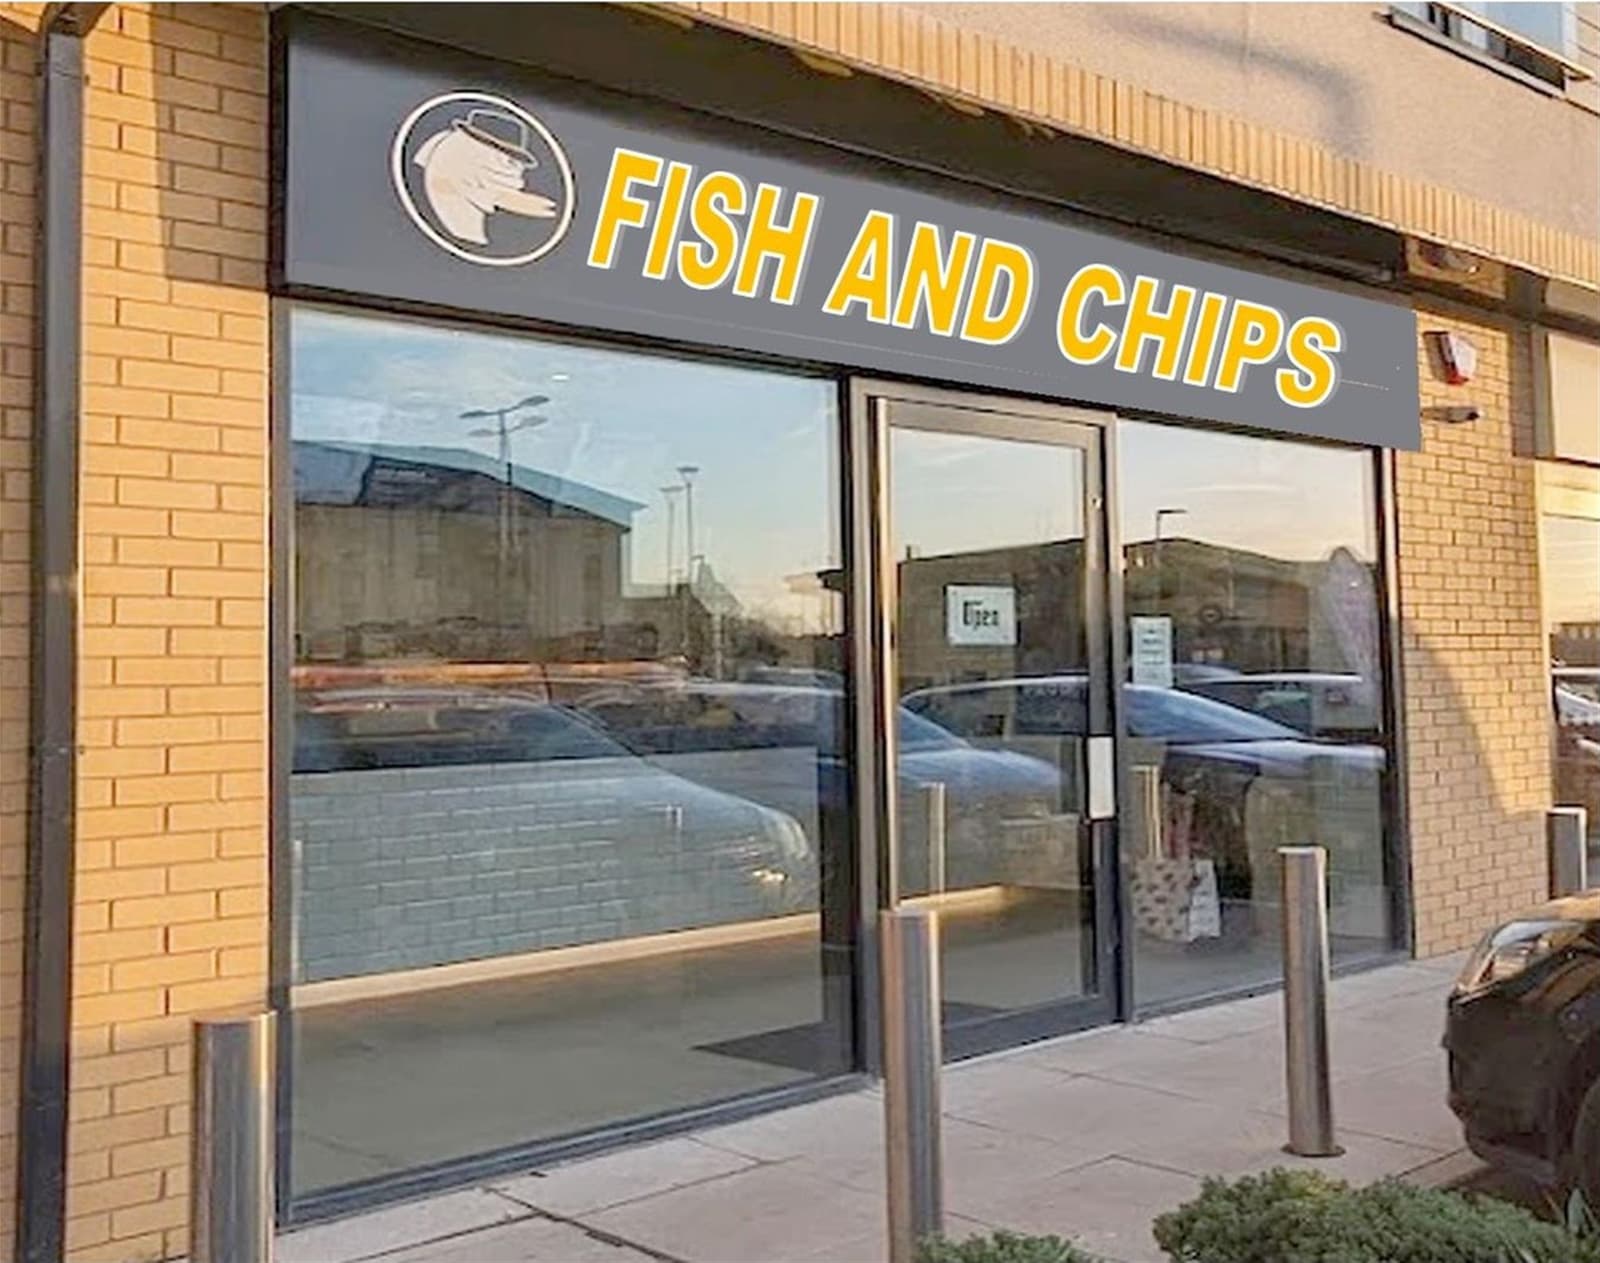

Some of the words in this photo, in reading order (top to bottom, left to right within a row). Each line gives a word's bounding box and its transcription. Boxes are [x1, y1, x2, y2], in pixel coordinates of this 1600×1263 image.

[588, 147, 818, 305] FISH
[822, 210, 1034, 345] AND
[1057, 264, 1342, 408] CHIPS
